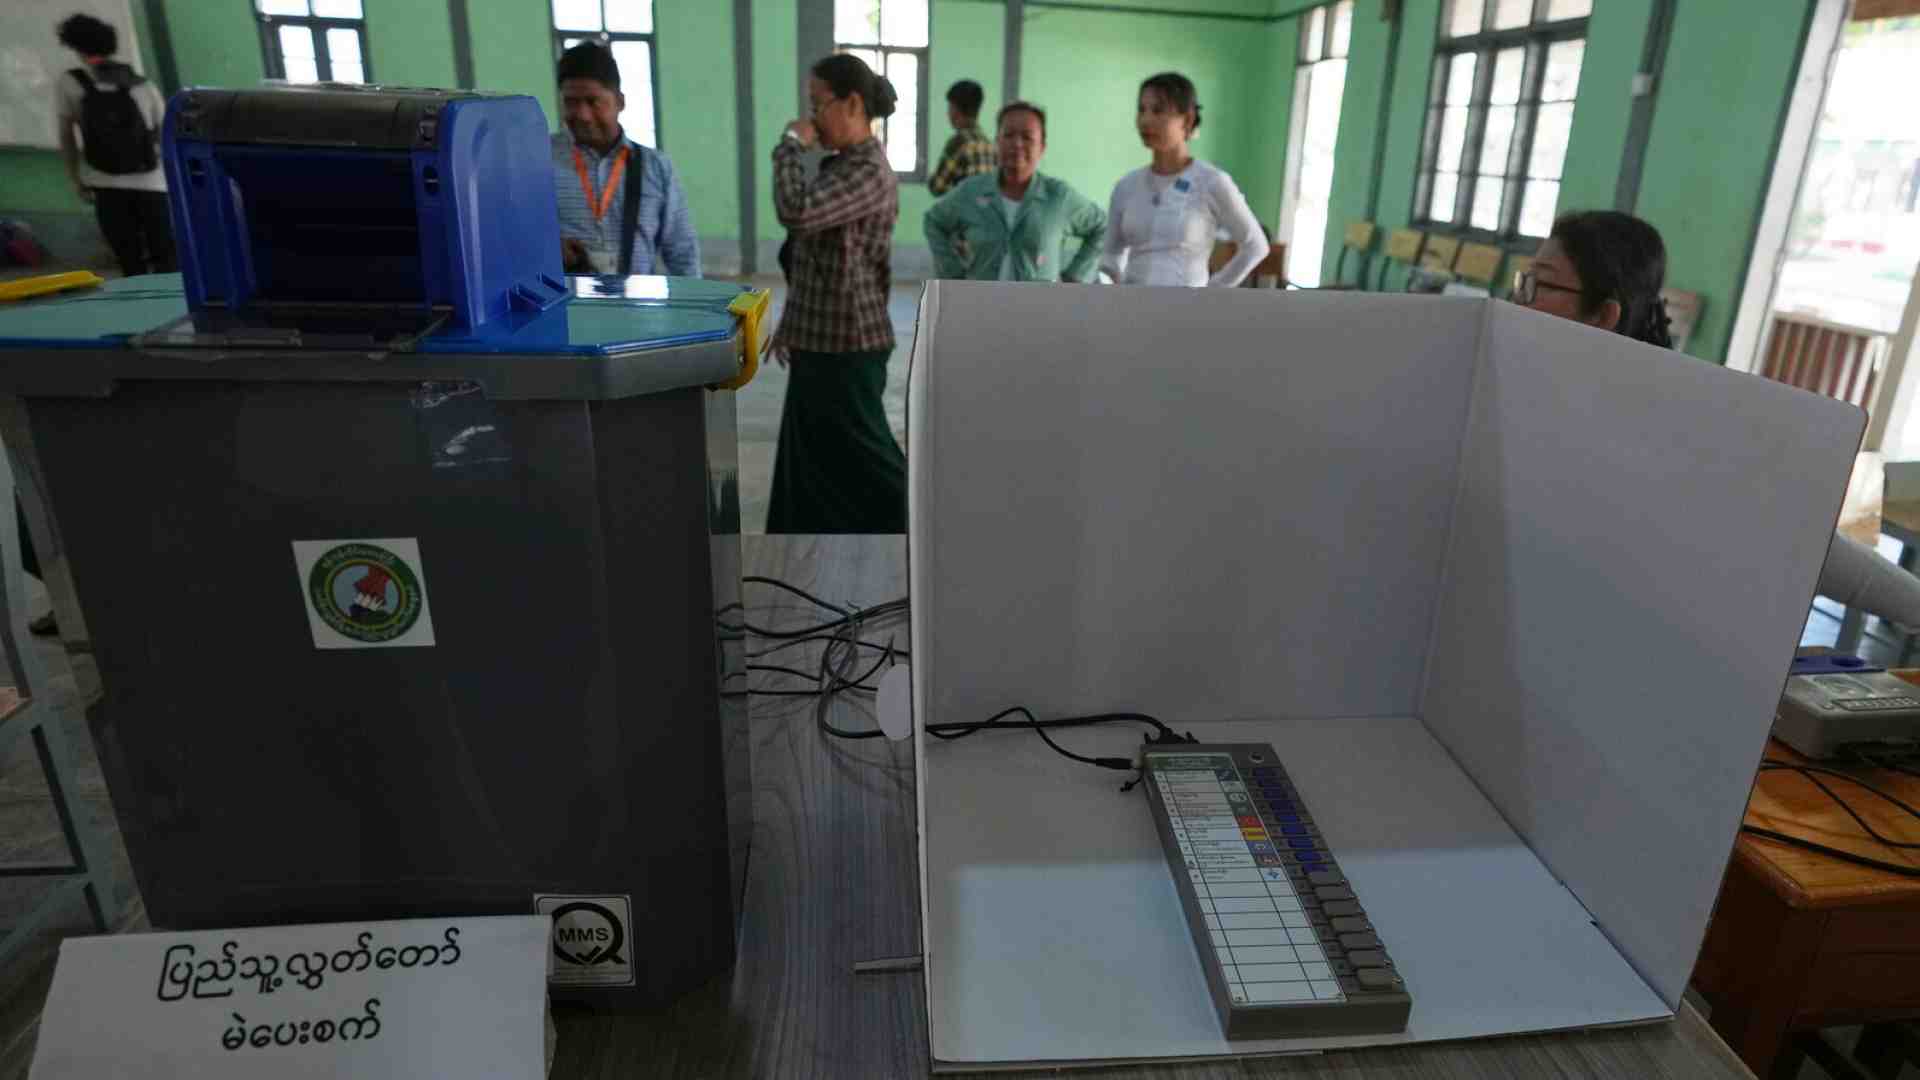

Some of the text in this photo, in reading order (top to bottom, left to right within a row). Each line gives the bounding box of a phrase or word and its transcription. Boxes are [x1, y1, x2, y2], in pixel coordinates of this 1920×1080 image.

[558, 927, 609, 943] MMS
[157, 927, 461, 1001] ပြည်သူ့လွှတ်တော်
[221, 999, 381, 1050] မဲပေးစက်
